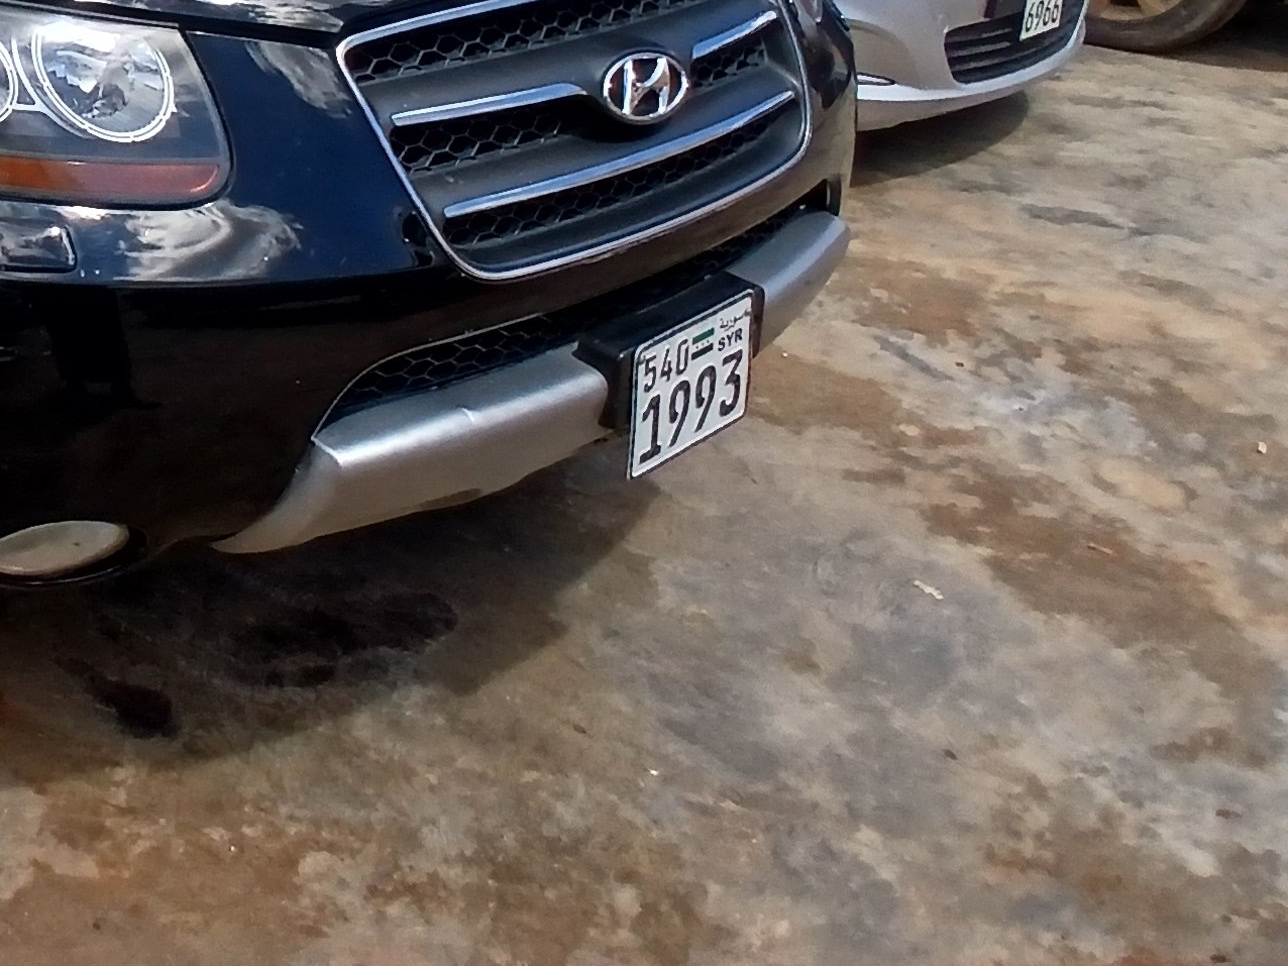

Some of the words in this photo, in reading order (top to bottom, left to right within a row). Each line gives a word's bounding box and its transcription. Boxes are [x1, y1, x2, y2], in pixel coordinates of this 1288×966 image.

[644, 338, 690, 393] 540
[718, 327, 743, 351] SYR
[639, 348, 744, 464] 1993
